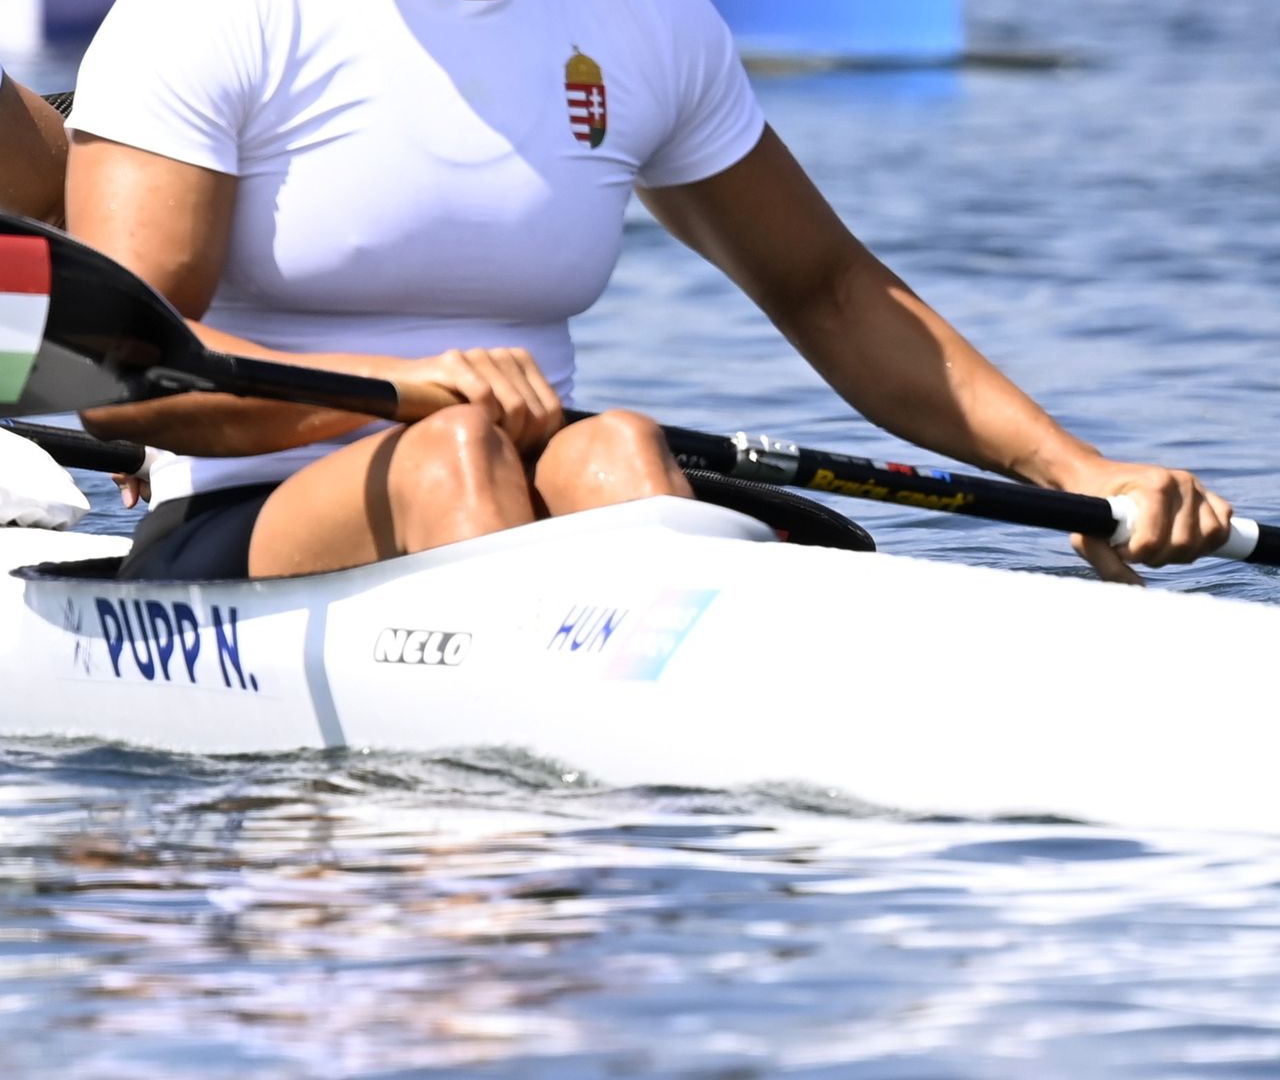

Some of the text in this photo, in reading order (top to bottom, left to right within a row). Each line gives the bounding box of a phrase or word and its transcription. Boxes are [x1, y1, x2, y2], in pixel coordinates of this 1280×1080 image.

[94, 596, 259, 692] PUPP N.
[373, 627, 473, 666] NELO
[547, 604, 630, 653] HUN
